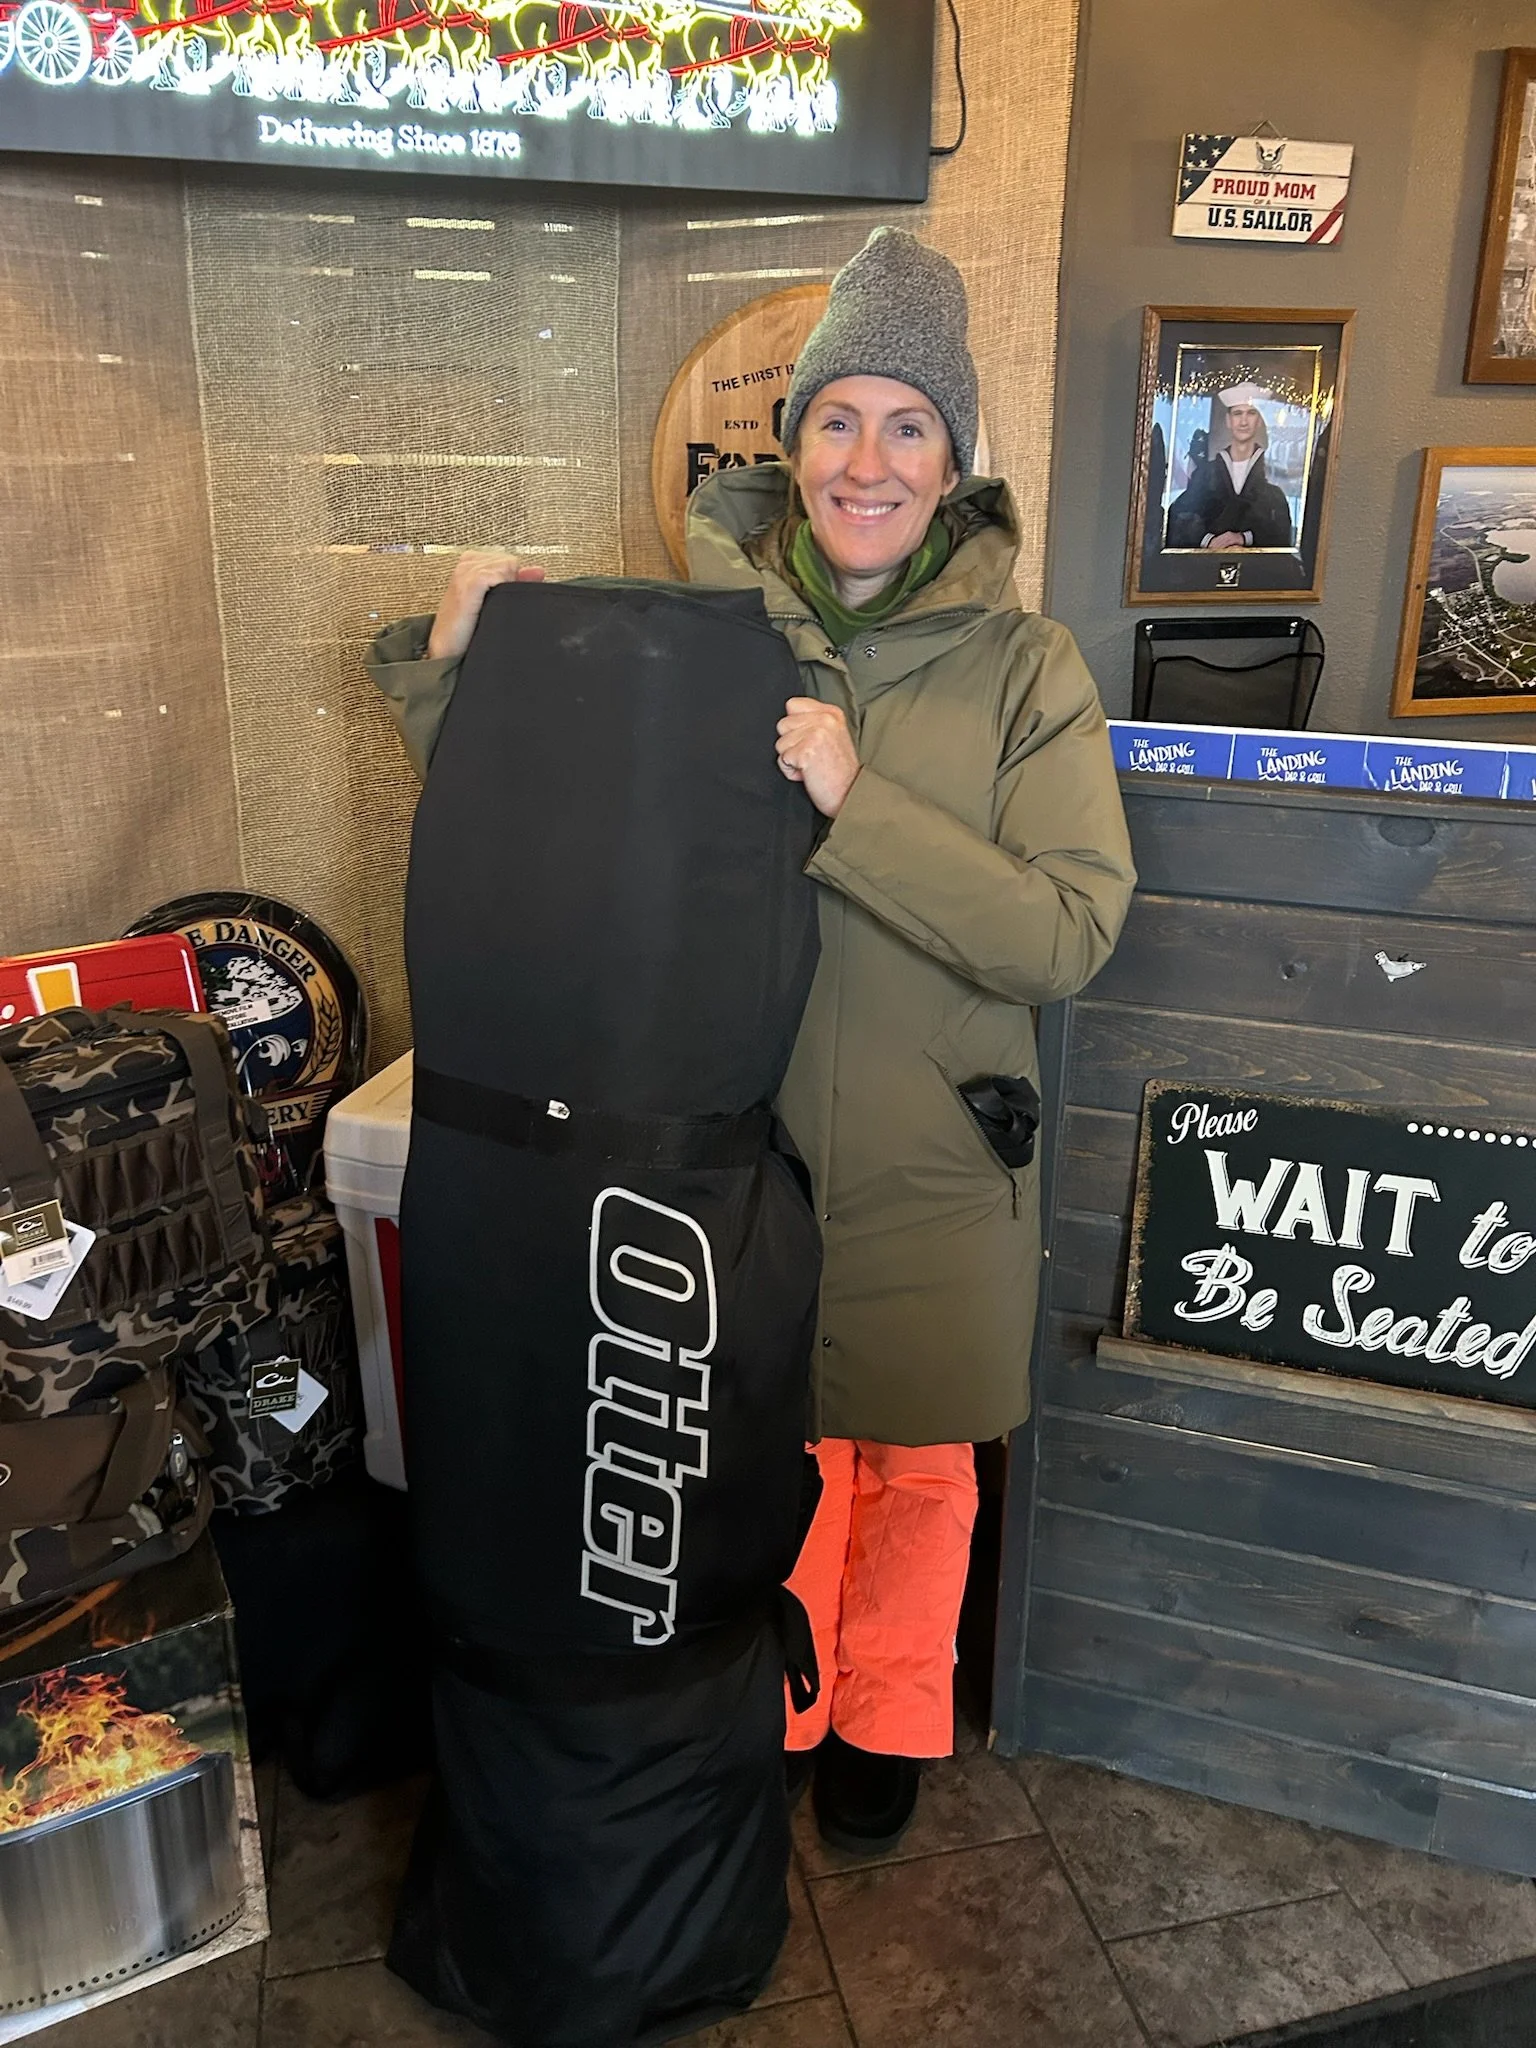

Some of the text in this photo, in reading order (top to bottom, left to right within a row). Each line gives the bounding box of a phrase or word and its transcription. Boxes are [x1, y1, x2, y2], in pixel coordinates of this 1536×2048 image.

[258, 115, 394, 157] Delivering
[398, 124, 466, 156] Since
[1212, 178, 1316, 200] PROUD MOM
[1208, 207, 1313, 232] U.S. SAILOR
[712, 377, 740, 393] THE
[742, 365, 782, 386] FIRST
[724, 420, 759, 430] ESTD
[1129, 742, 1195, 766] LANDING
[1133, 738, 1150, 749] THE
[1261, 747, 1279, 757] THE
[1256, 750, 1327, 776] LANDING
[1390, 760, 1464, 785] LANDING
[1394, 756, 1413, 766] THE
[215, 921, 317, 983] DANGER
[1166, 1102, 1259, 1145] Please
[1204, 1149, 1536, 1275] WAIT to
[1173, 1242, 1536, 1380] Be Seated
[253, 1394, 296, 1409] DRAKE
[580, 1185, 718, 1648] Otter
